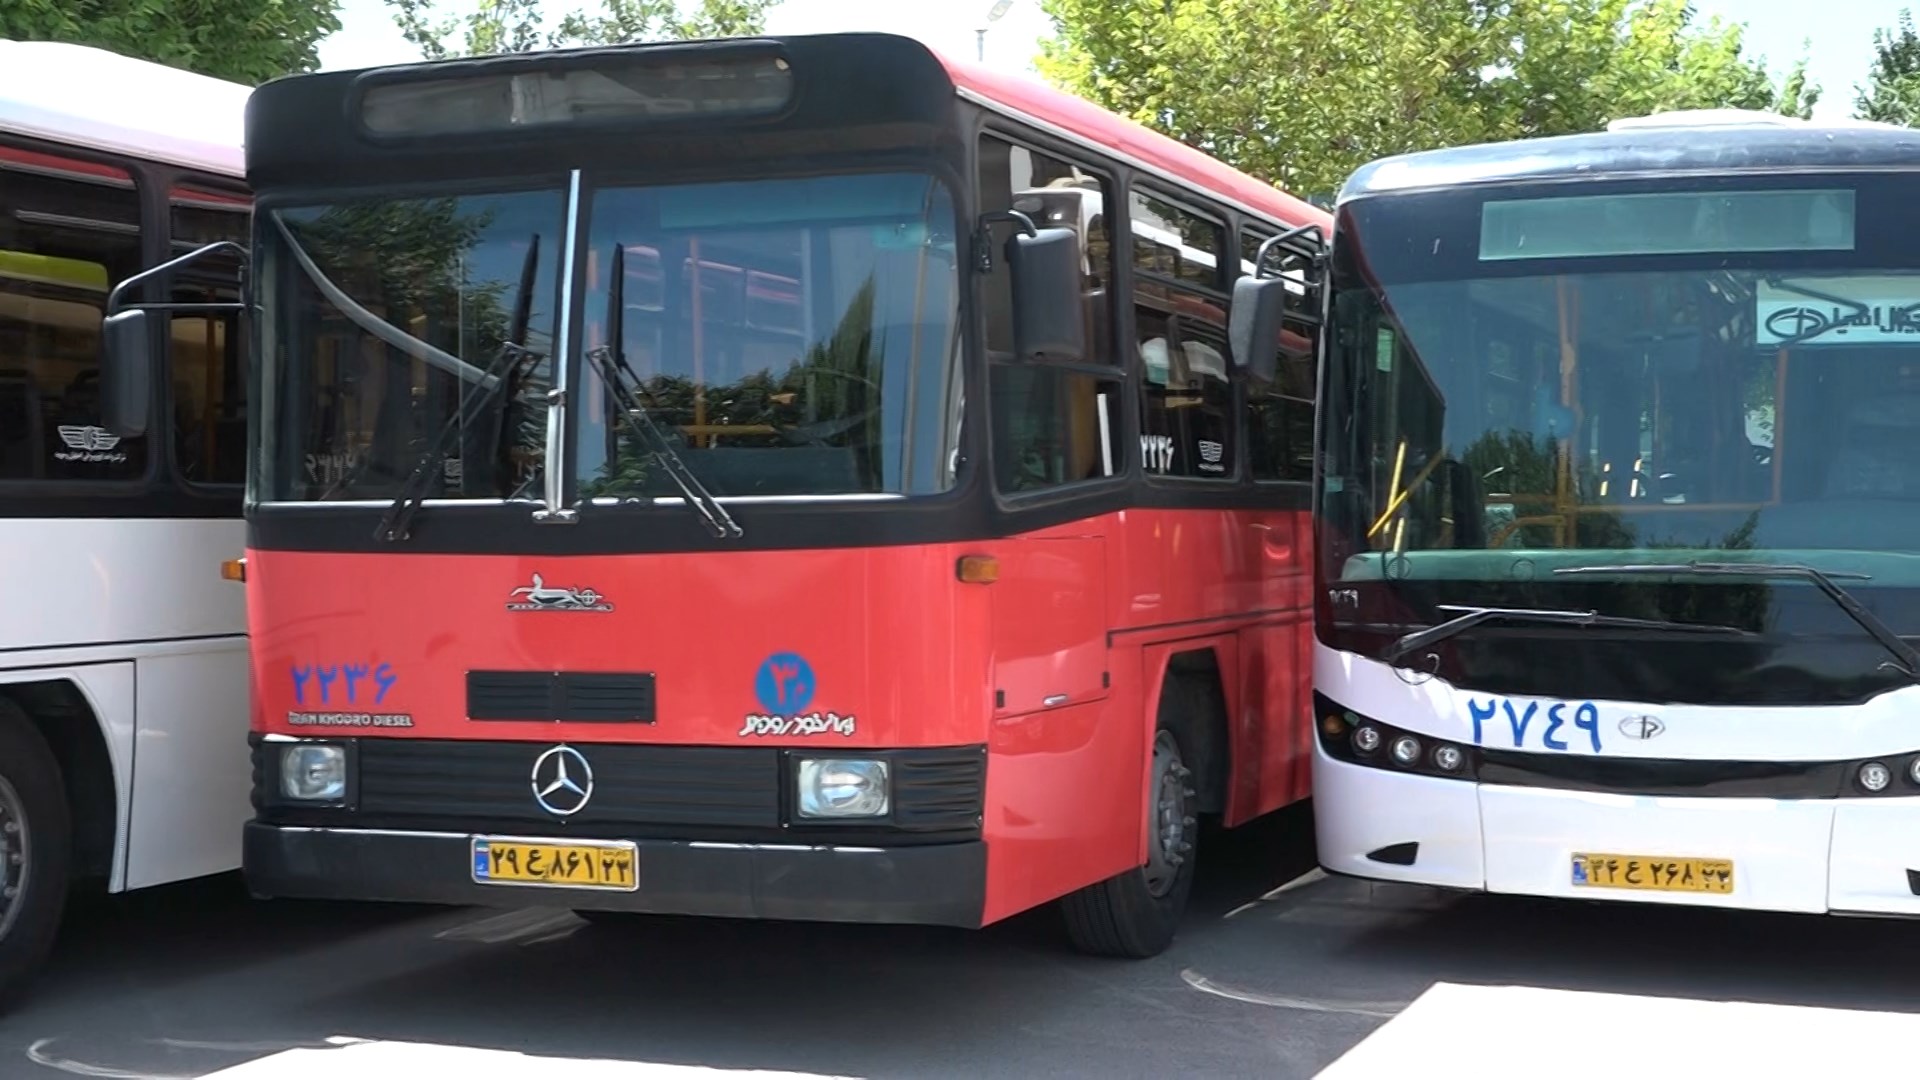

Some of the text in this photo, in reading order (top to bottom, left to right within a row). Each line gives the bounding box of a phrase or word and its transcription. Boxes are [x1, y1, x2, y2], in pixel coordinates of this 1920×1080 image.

[291, 662, 397, 704] ۲۲۳۶
[287, 711, 414, 727] IRAN KHODRO DIESEL
